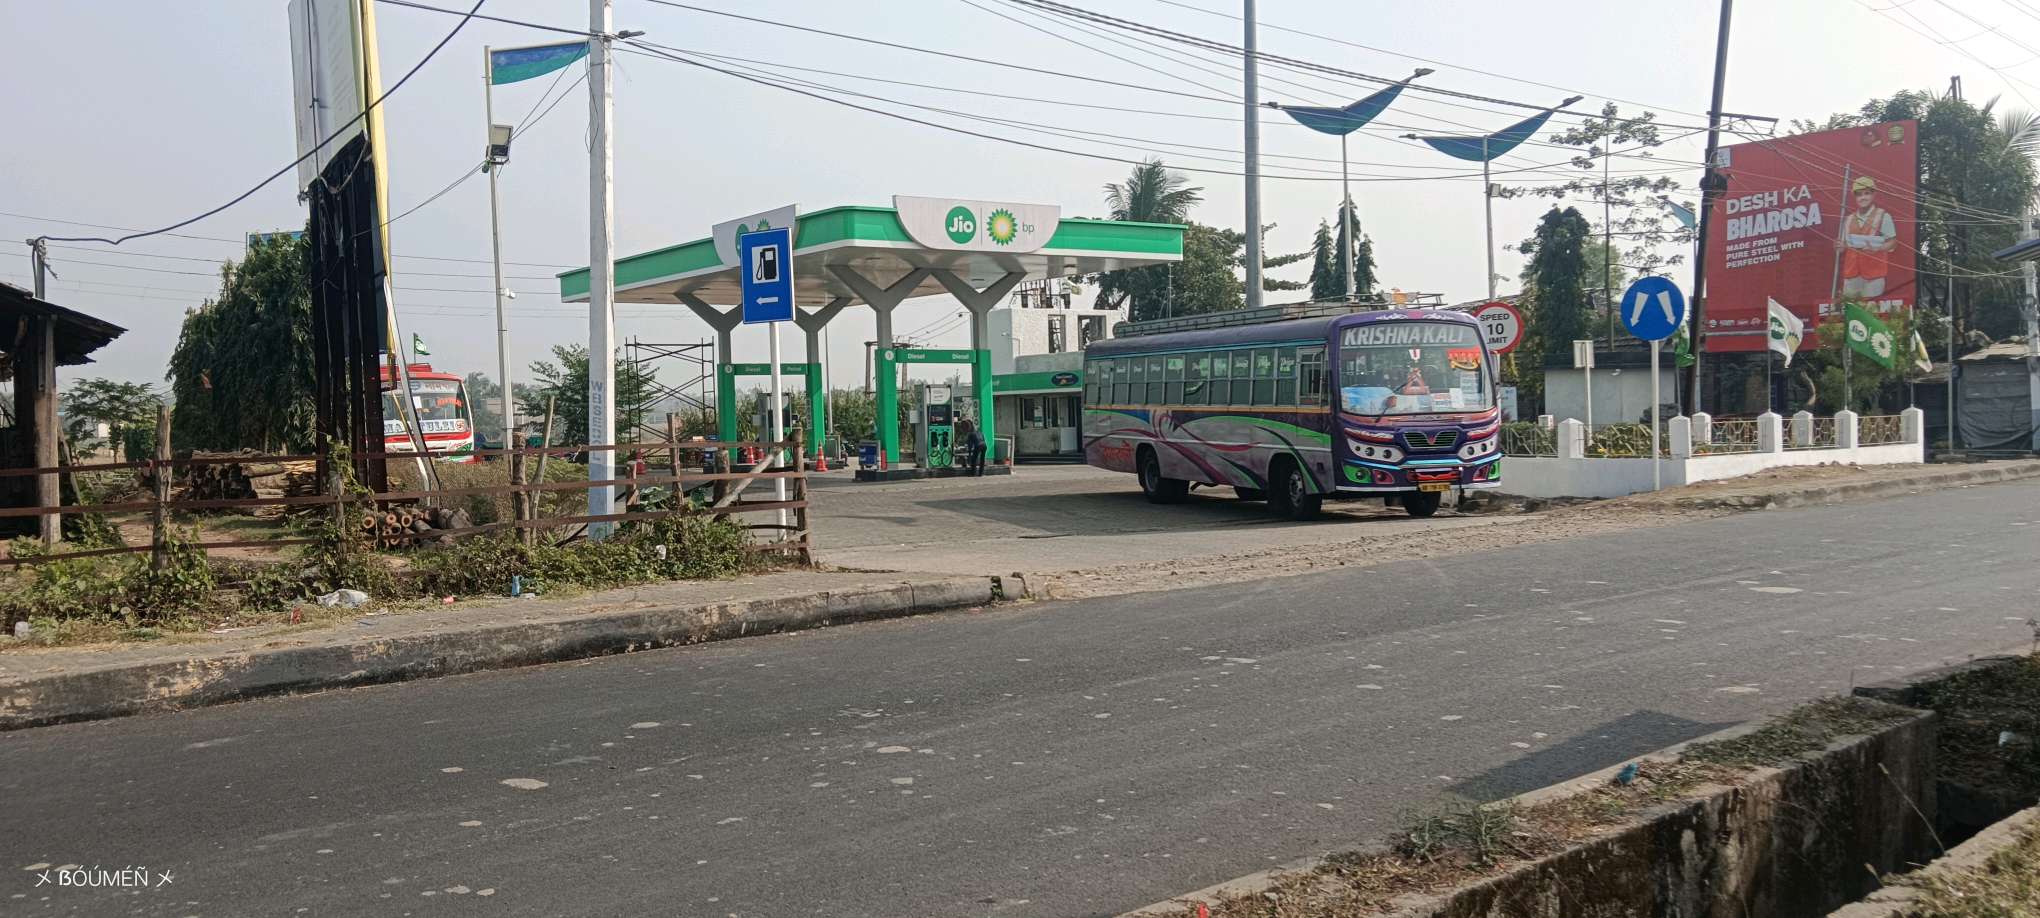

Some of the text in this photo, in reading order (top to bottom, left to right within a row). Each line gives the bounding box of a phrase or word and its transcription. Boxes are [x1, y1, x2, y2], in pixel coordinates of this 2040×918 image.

[1726, 184, 1812, 215] DESH KA
[948, 215, 974, 233] Jio
[1022, 221, 1036, 236] bp
[1726, 202, 1822, 241] BHAROSA
[1726, 236, 1778, 253] MADE FROM
[1726, 240, 1805, 261] PURE STEEL WITH
[1726, 252, 1781, 269] PERFECTION
[1480, 313, 1510, 322] SPEED
[1487, 322, 1505, 336] 10
